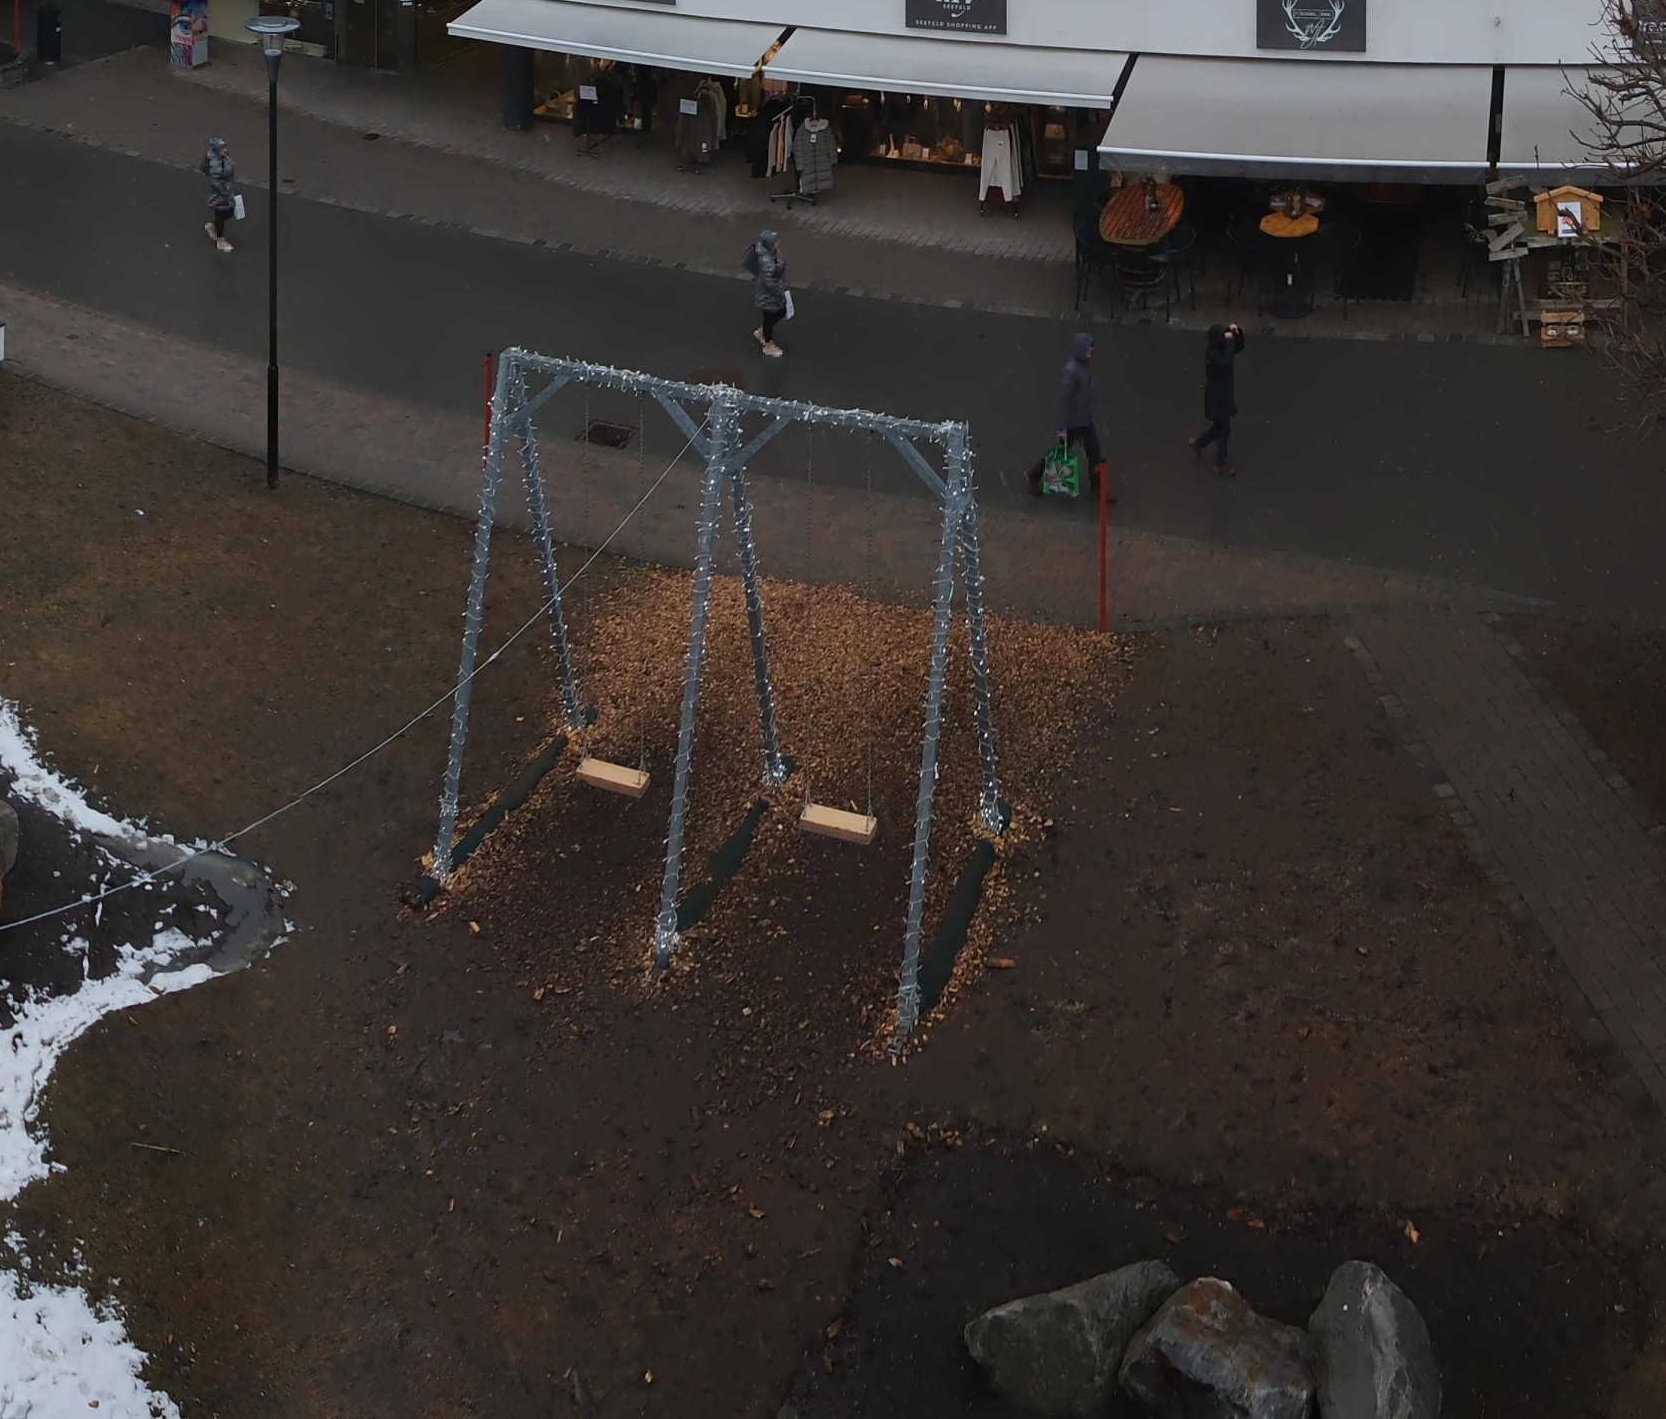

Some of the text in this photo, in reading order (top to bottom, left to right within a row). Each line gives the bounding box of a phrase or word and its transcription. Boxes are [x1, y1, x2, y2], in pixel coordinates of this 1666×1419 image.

[942, 3, 971, 11] SEEFELD
[915, 19, 944, 27] SEEFELD
[946, 21, 982, 30] SHOPPING
